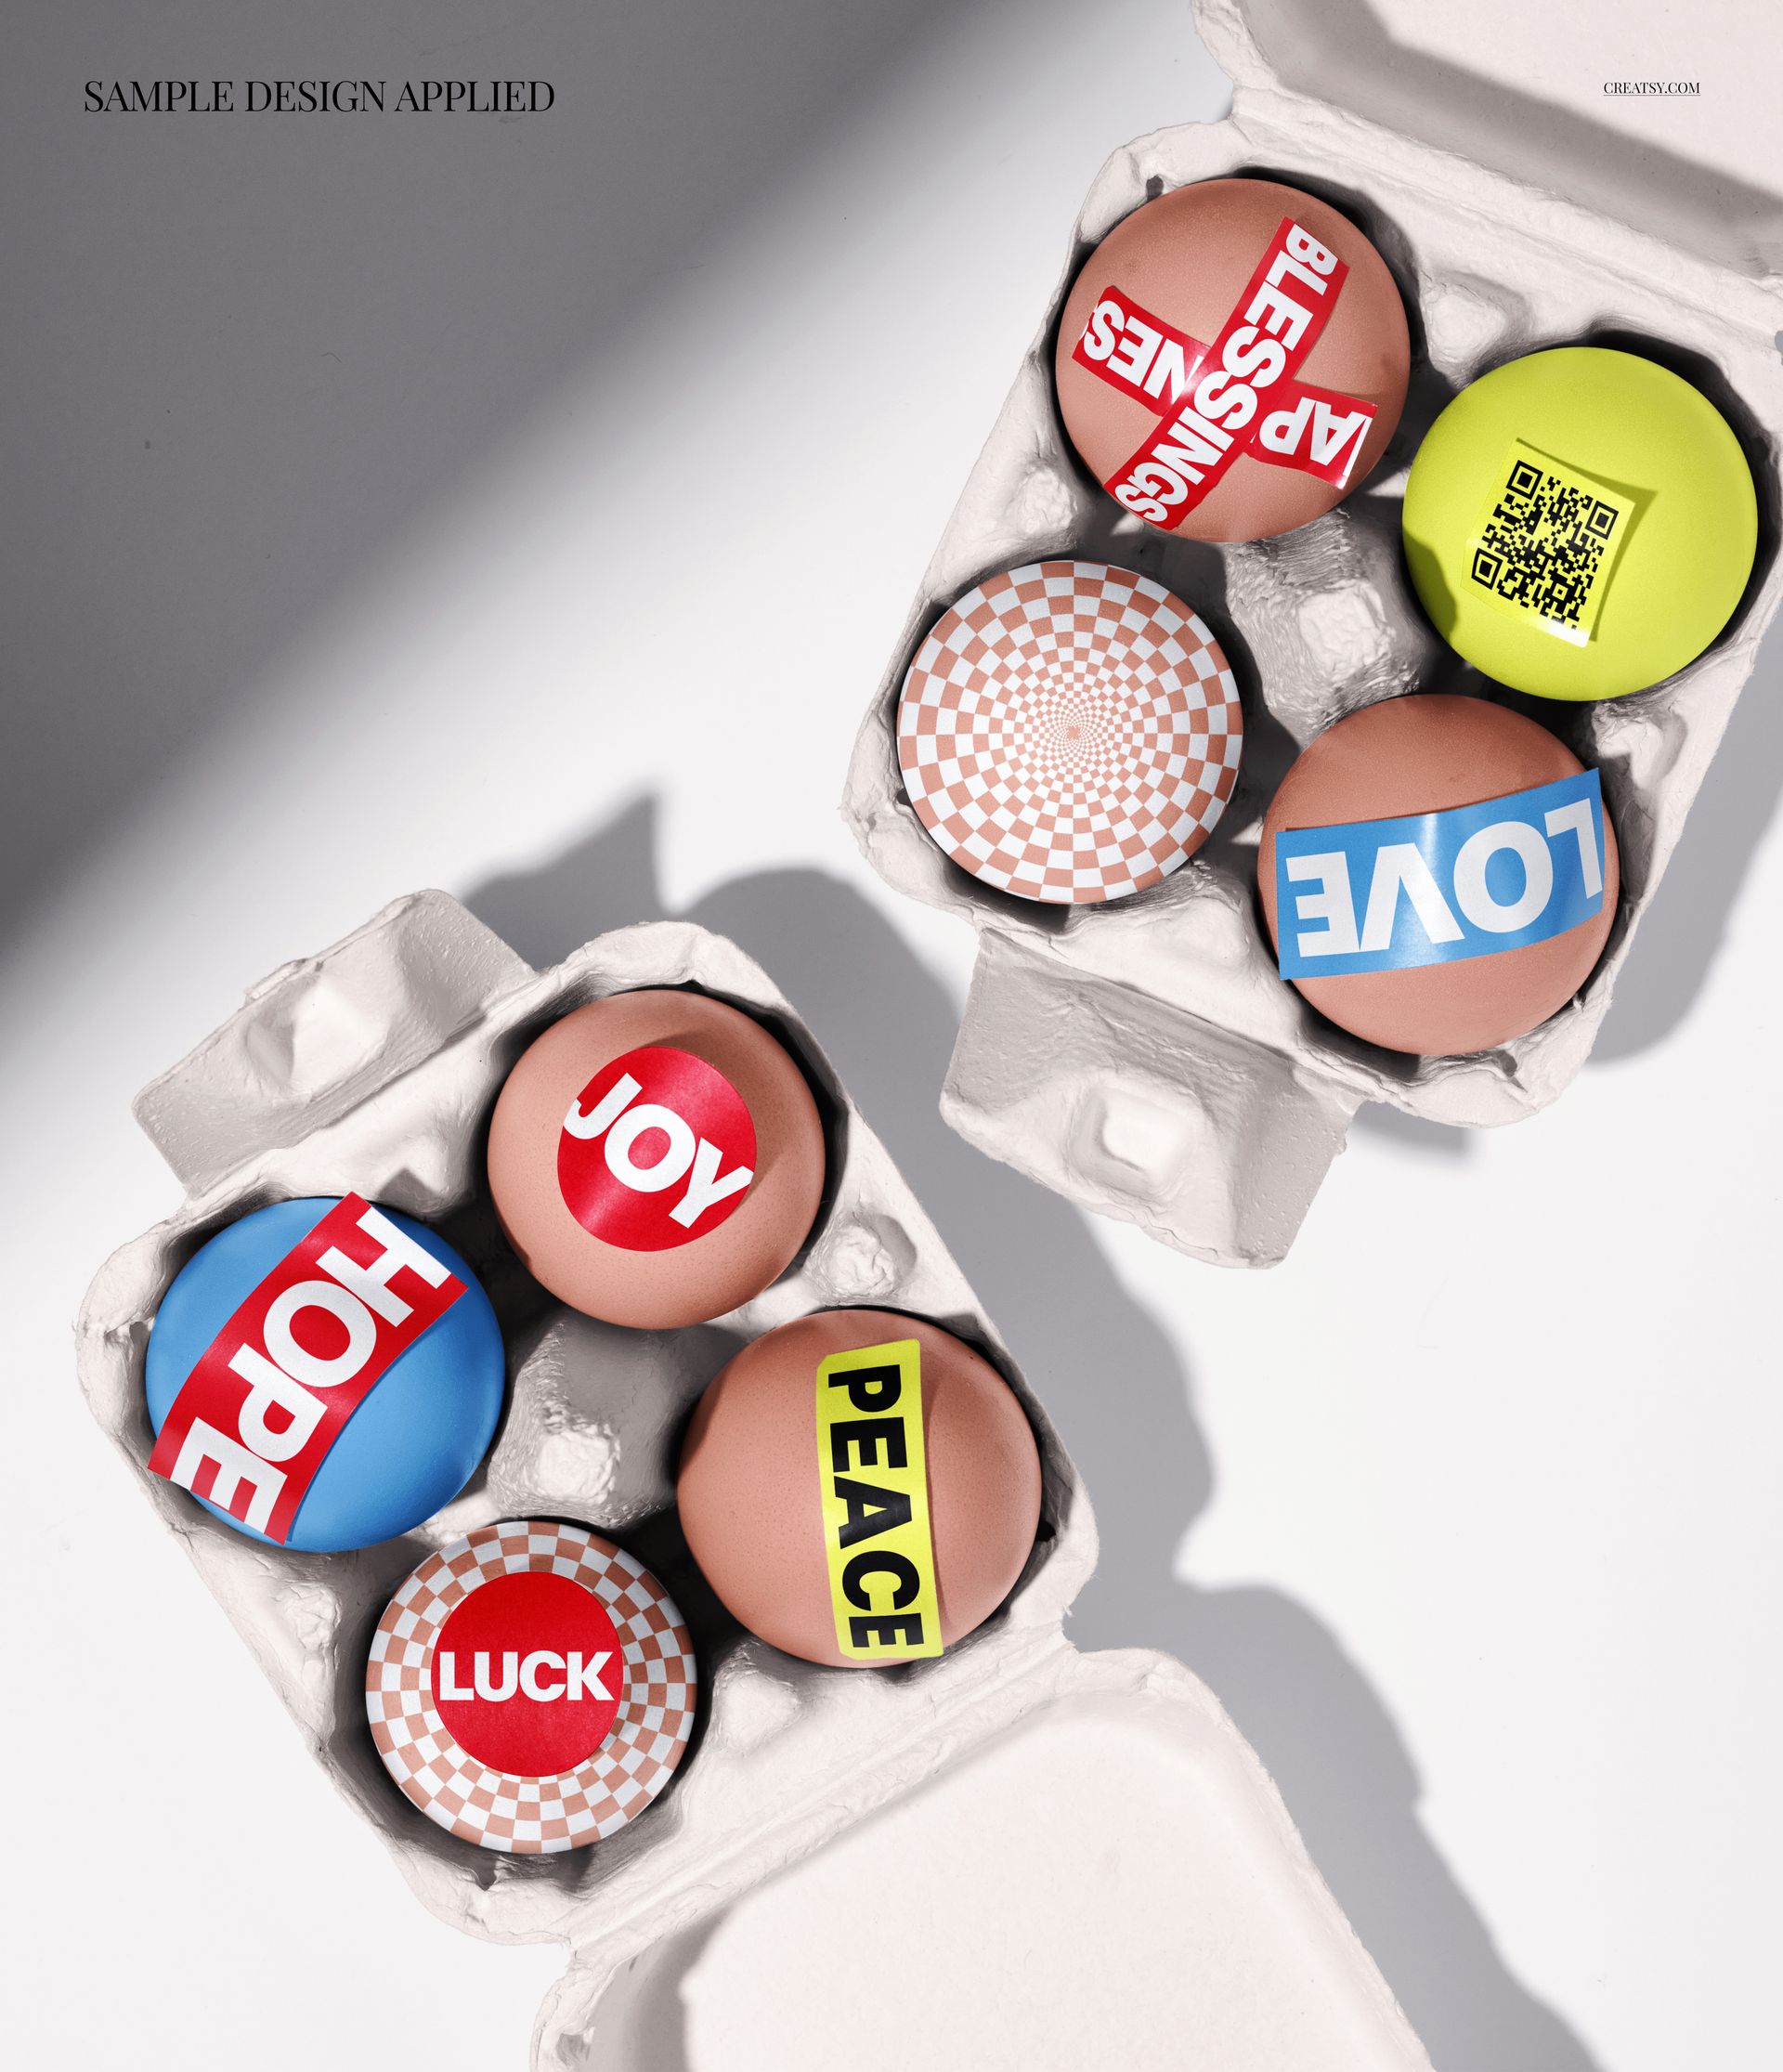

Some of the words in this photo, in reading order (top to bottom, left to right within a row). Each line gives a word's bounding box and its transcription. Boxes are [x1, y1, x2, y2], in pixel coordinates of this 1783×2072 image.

[1114, 223, 1338, 523] BLESSINGS
[1285, 797, 1603, 958] LOVE
[563, 1072, 755, 1230] JOY
[170, 1206, 452, 1535] HOPE
[827, 1363, 925, 1648] PEACE
[439, 1649, 615, 1702] LUCK
